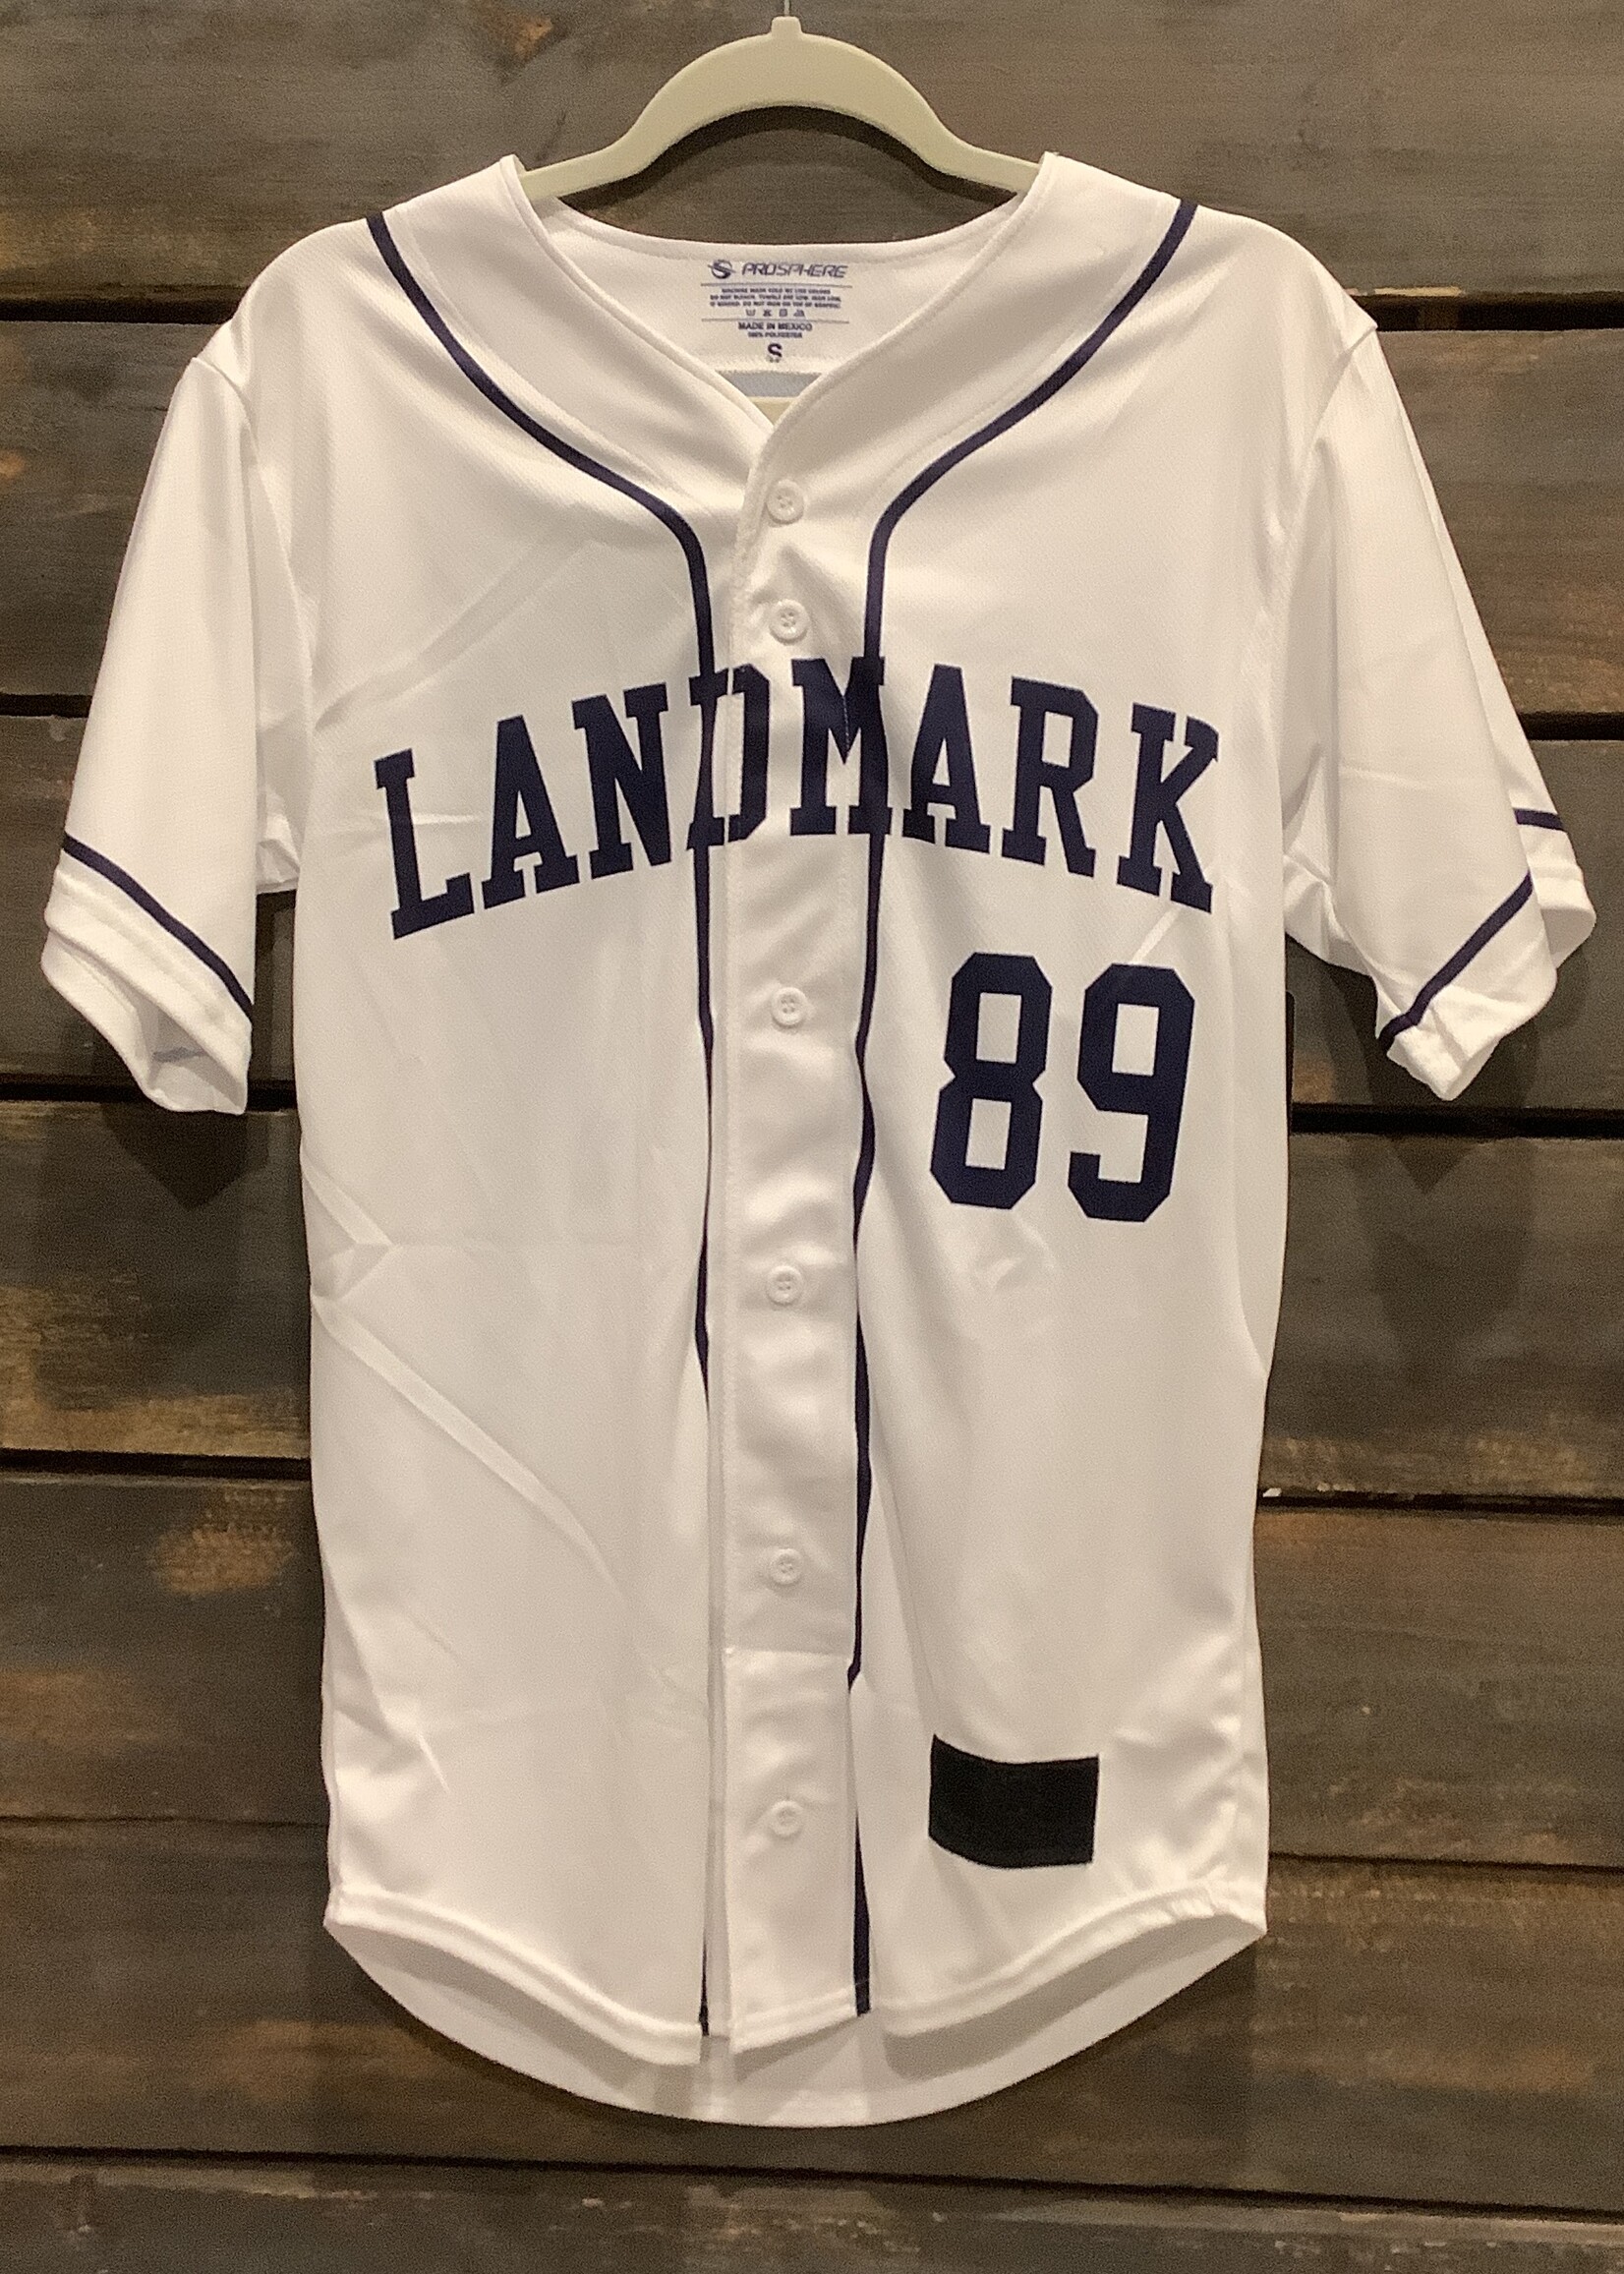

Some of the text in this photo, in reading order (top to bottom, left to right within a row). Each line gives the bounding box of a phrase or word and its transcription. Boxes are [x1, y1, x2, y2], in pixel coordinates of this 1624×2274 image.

[742, 262, 848, 278] PROSPHERE
[738, 321, 813, 331] MADE IN MEXICO
[767, 342, 783, 363] S
[374, 656, 1220, 941] LANDMARK
[930, 952, 1196, 1223] 89
